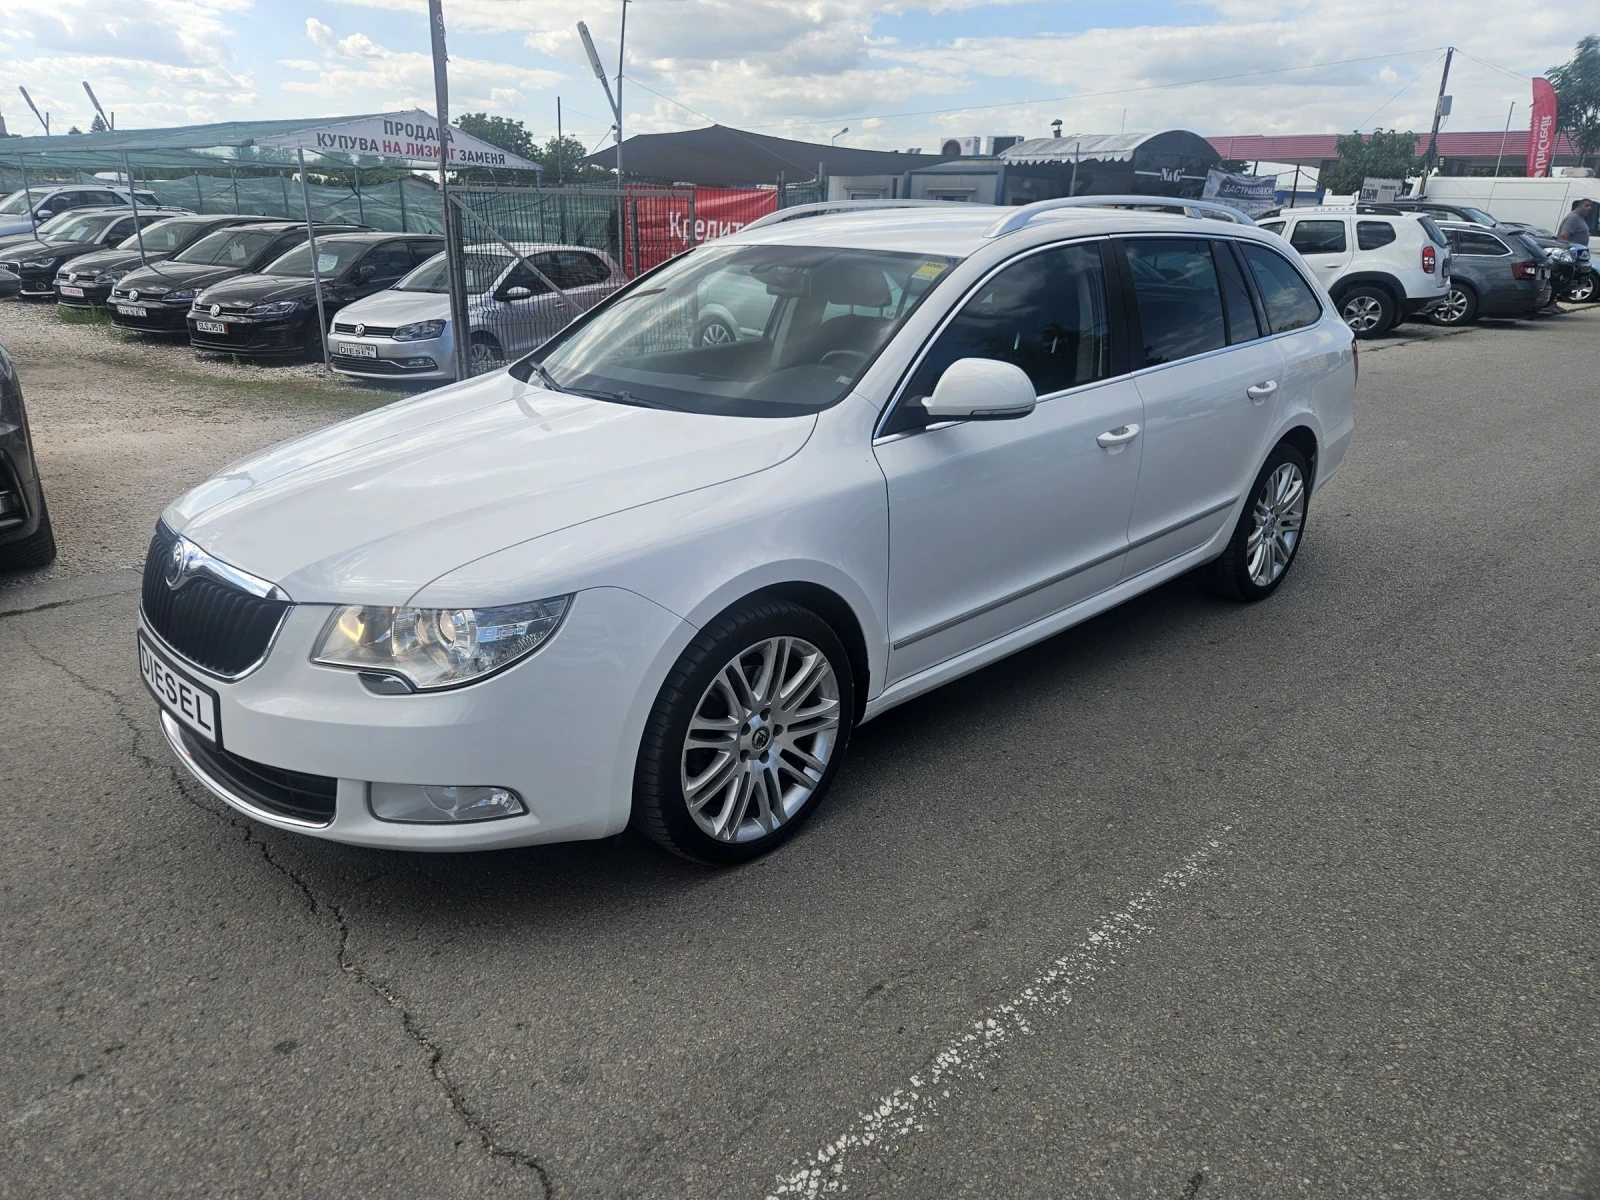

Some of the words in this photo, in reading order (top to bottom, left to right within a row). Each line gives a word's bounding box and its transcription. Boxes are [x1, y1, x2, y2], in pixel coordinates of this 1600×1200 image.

[316, 132, 379, 152] КУПУВА
[383, 139, 402, 155] НА
[459, 149, 506, 165] ЗАМЕНЯ
[340, 346, 372, 356] DIESEL
[141, 644, 212, 732] DIESEL
